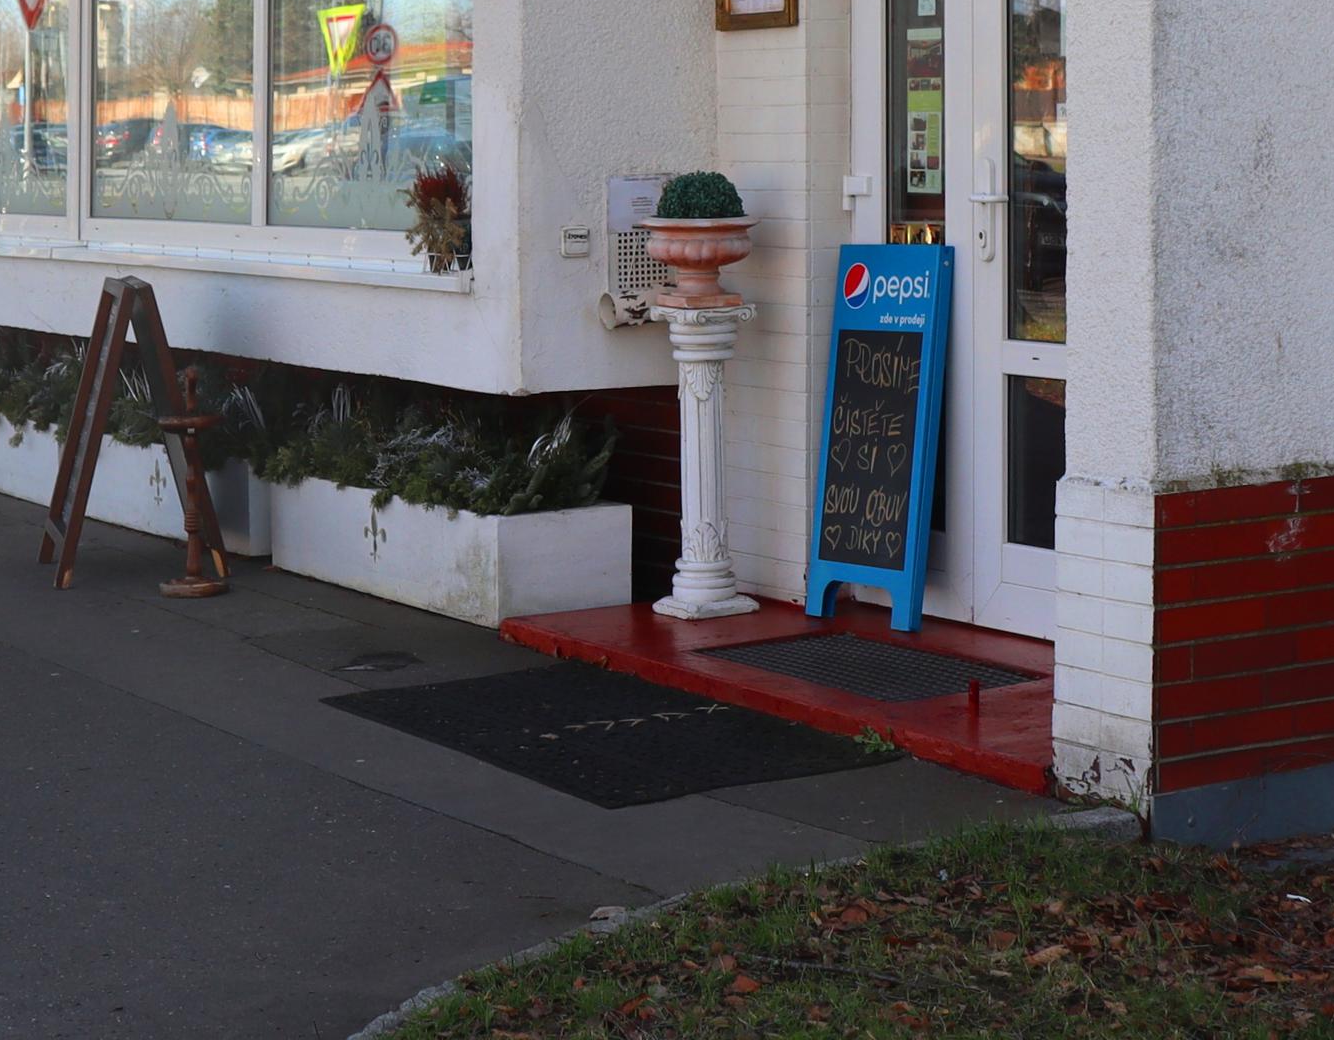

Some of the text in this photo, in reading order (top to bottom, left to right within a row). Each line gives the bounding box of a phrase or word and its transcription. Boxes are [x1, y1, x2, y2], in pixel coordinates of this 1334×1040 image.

[872, 270, 930, 305] pepsi
[879, 312, 893, 325] zde
[899, 313, 926, 328] prodeji
[844, 335, 921, 395] PROSÍME
[833, 392, 904, 437] ČISTĚTE
[845, 516, 882, 555] DÍKY
